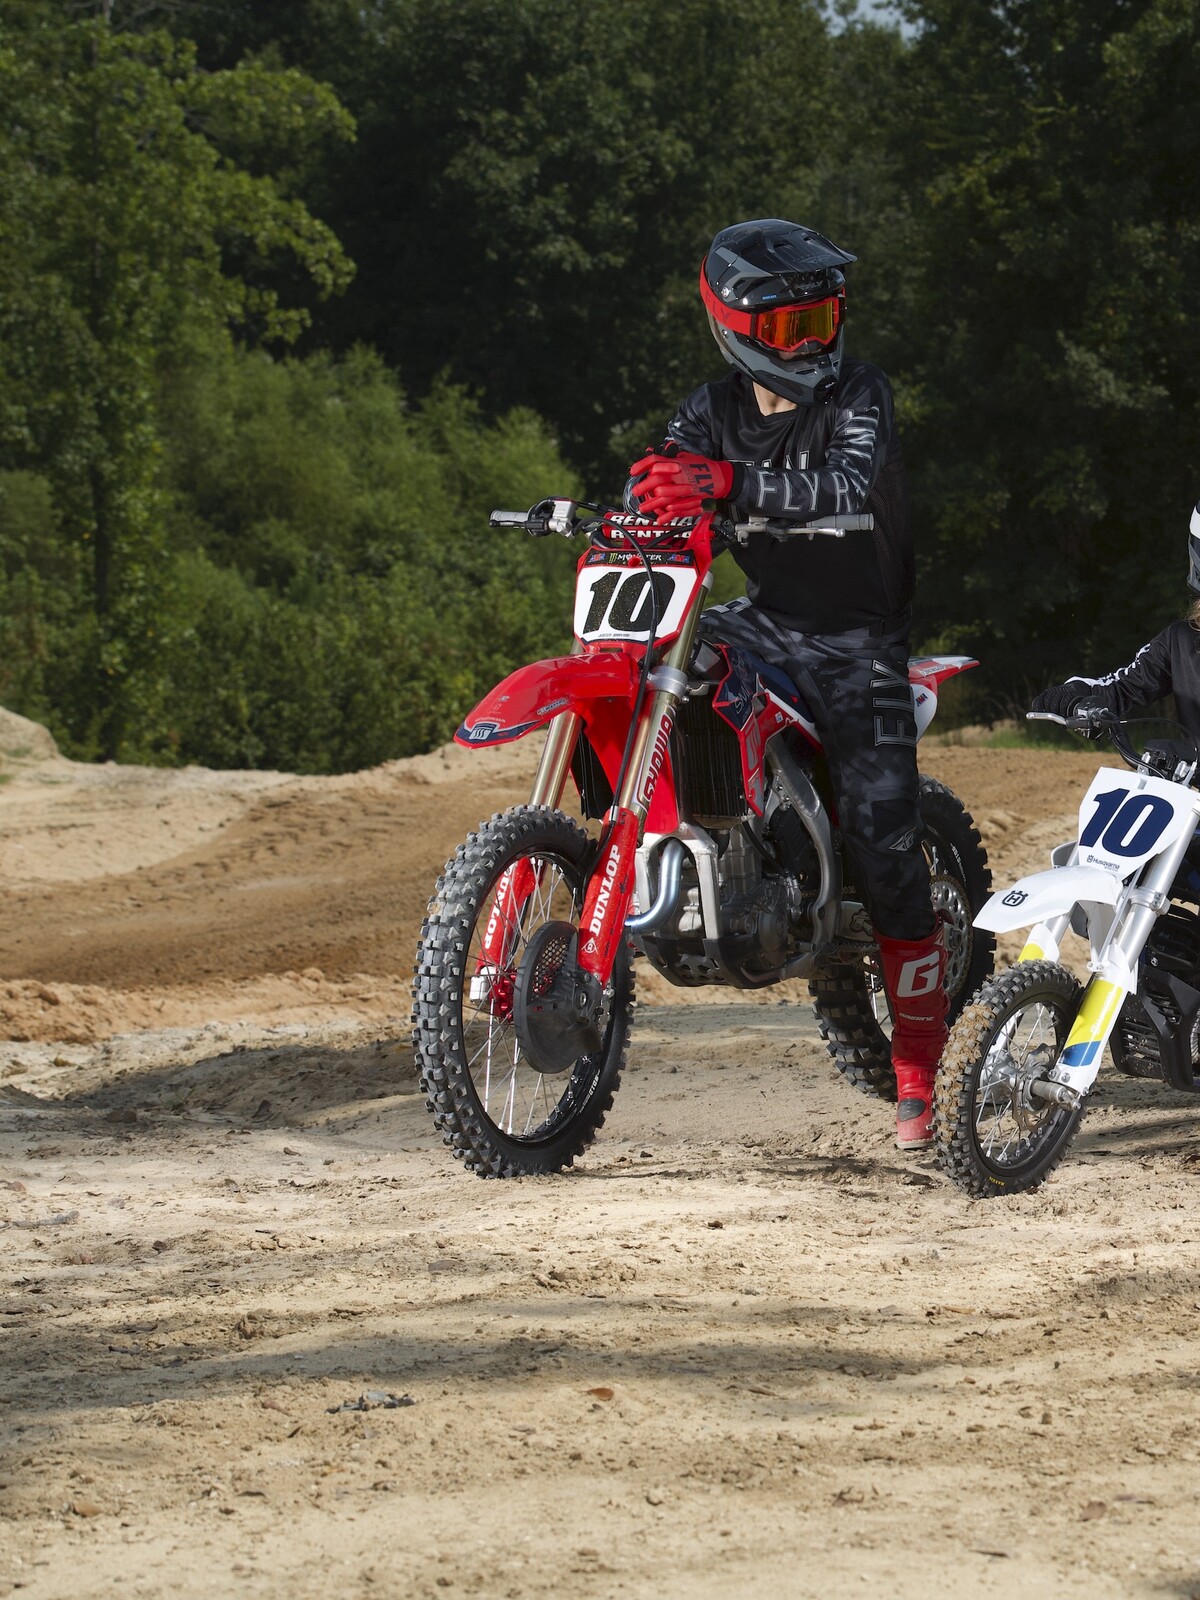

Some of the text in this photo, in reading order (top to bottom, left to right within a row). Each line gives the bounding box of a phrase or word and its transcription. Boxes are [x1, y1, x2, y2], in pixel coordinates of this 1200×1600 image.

[690, 463, 714, 497] FLY
[757, 470, 820, 512] FLY
[610, 515, 703, 526] RENHA
[617, 553, 662, 561] MOTER
[582, 571, 676, 634] 10
[1079, 788, 1175, 858] 10
[589, 844, 622, 937] DUNLOP
